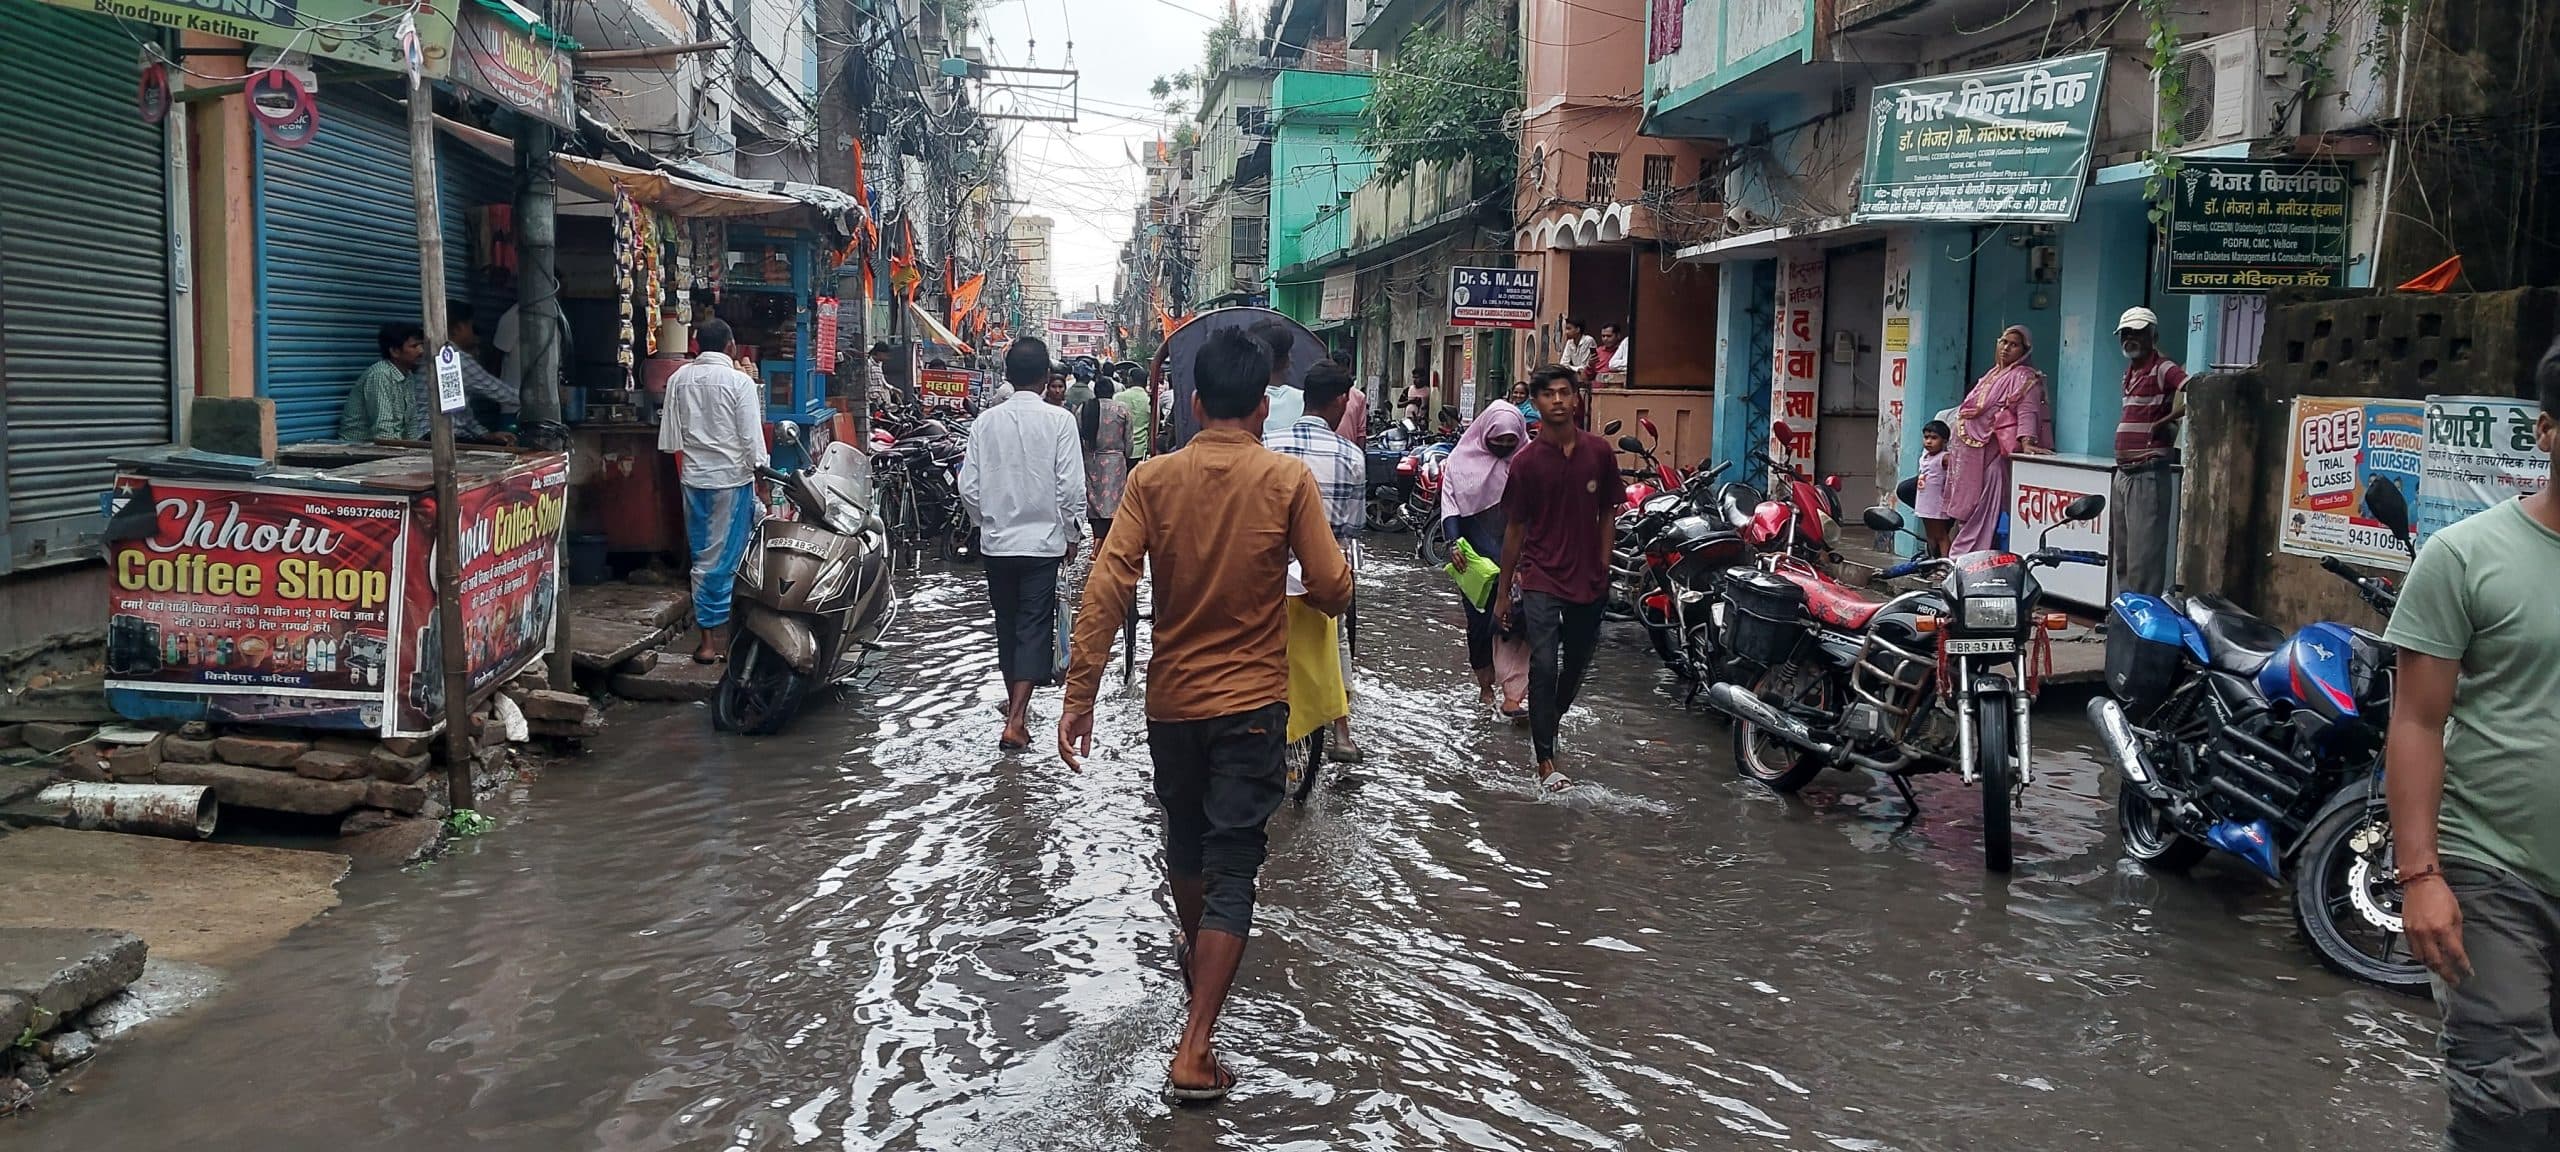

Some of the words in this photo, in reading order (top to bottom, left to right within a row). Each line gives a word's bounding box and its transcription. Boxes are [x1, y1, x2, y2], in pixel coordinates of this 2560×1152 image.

[94, 0, 182, 27] Binodpur
[187, 13, 259, 41] Katihar
[502, 30, 534, 77] Coffee
[1895, 88, 1954, 124] मेजर
[1917, 124, 1954, 153] (मेजर)
[2208, 168, 2254, 192] मेजर
[2222, 199, 2254, 217] (मेजर)
[2222, 237, 2251, 249] PGDFM,
[2252, 238, 2271, 249] CMC,
[2273, 238, 2298, 249] Vellore
[2173, 250, 2196, 261] Trained
[2196, 250, 2203, 261] in
[2204, 251, 2230, 261] Diabetes
[2231, 251, 2271, 264] Management
[2271, 252, 2277, 262] &
[2277, 252, 2311, 262] Consultant
[1459, 271, 1476, 285] Dr.
[1480, 272, 1492, 286] S.
[1495, 272, 1510, 286] M.
[1513, 273, 1534, 287] ALI
[2180, 272, 2229, 286] हाजरा
[2232, 270, 2294, 286] मेडिकल
[2302, 410, 2361, 457] FREE
[2318, 457, 2345, 472] TRIAL
[2311, 471, 2352, 488] CLASSES
[2315, 495, 2333, 506] Limited
[2334, 493, 2348, 504] Seats
[305, 502, 335, 517] Mob.-
[336, 504, 401, 521] 9693726082
[146, 498, 345, 556] Chhotu
[493, 499, 534, 557] Coffee
[117, 549, 262, 597] Coffee
[277, 558, 387, 609] Shop
[315, 608, 327, 619] पर
[329, 607, 350, 620] दिया
[354, 610, 375, 622] जाता
[377, 610, 385, 622] है
[1917, 603, 1937, 616] Hero
[198, 618, 220, 629] D.J.
[246, 618, 256, 630] के
[259, 618, 277, 631] लिए
[1956, 642, 1970, 653] BR
[1974, 642, 1988, 652] 39
[1991, 641, 2005, 652] AA
[261, 673, 302, 685] कटिहार
